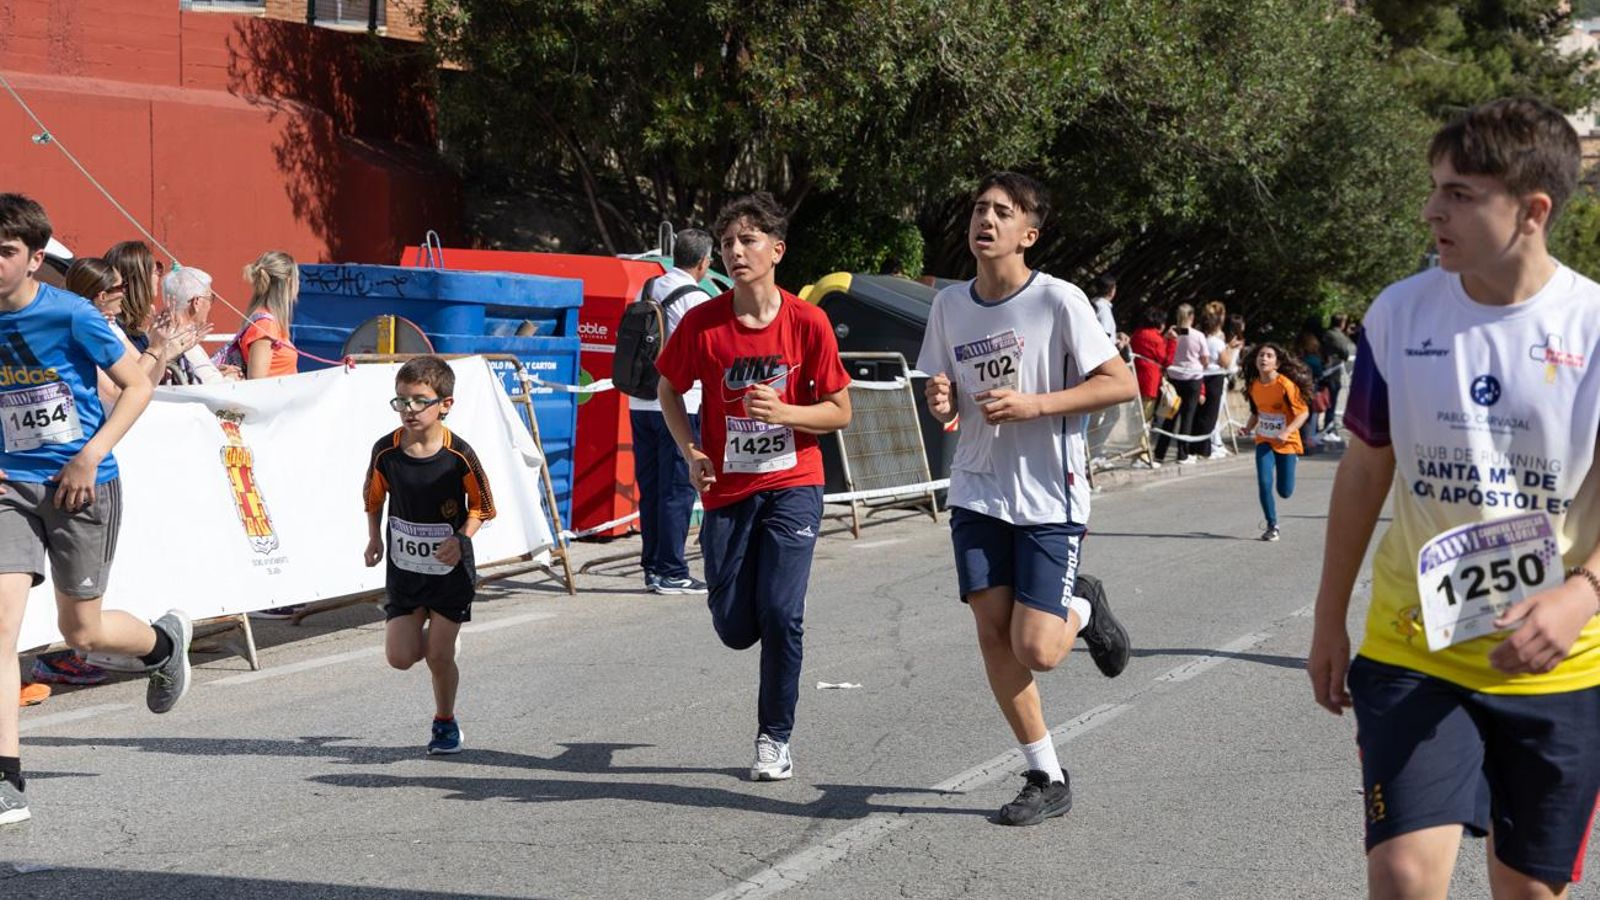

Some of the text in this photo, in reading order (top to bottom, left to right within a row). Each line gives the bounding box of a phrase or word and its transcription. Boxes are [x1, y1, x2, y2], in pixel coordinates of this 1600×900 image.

[525, 361, 531, 370] Y
[729, 355, 783, 381] NIKE
[974, 355, 1016, 382] 702
[10, 404, 68, 431] 1454
[730, 434, 787, 455] 1425
[1415, 444, 1561, 473] CLUB DE RUNNING
[1418, 460, 1481, 482] SANTA
[1523, 471, 1557, 491] DE
[1437, 553, 1545, 606] 1250
